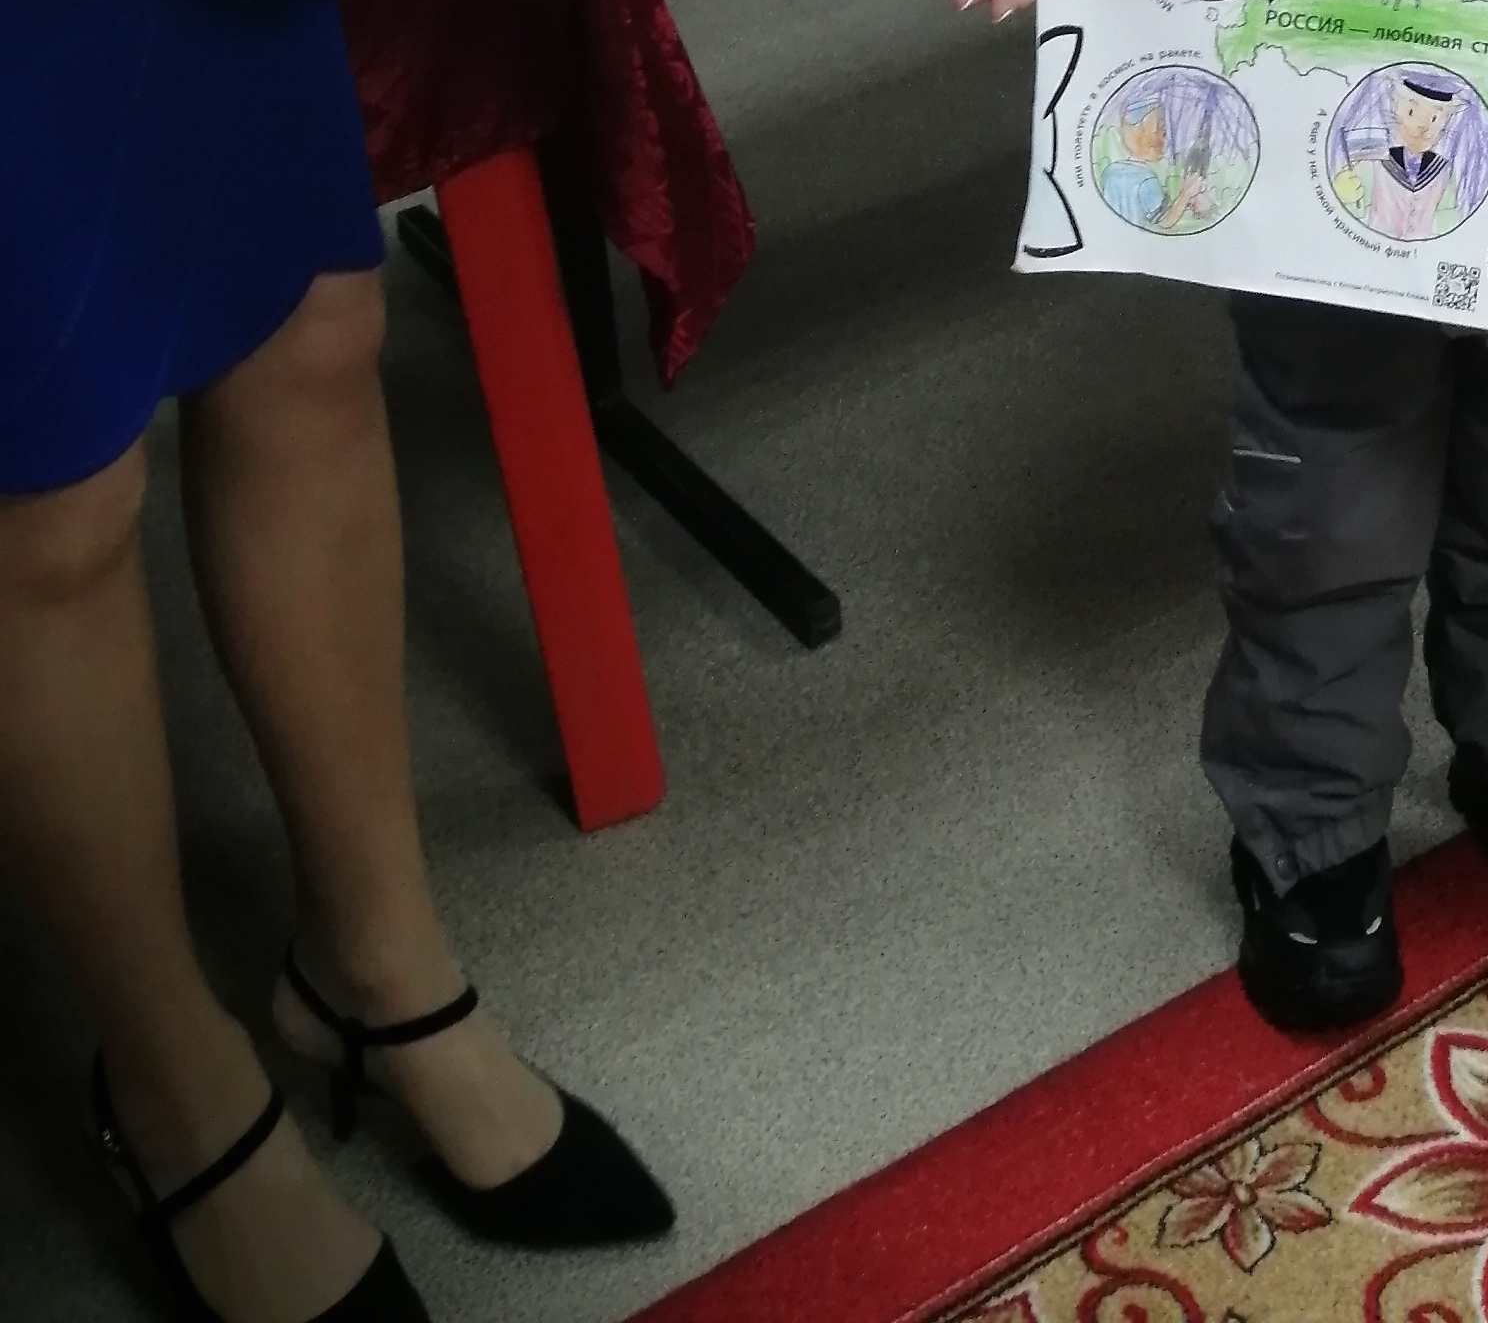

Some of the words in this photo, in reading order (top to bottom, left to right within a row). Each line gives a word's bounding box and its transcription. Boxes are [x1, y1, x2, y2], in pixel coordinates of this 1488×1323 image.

[1265, 9, 1345, 34] РОССИЯ
[1373, 26, 1463, 51] любимая
[1308, 161, 1318, 181] нас
[1315, 185, 1334, 216] такой
[1333, 217, 1381, 253] красивый
